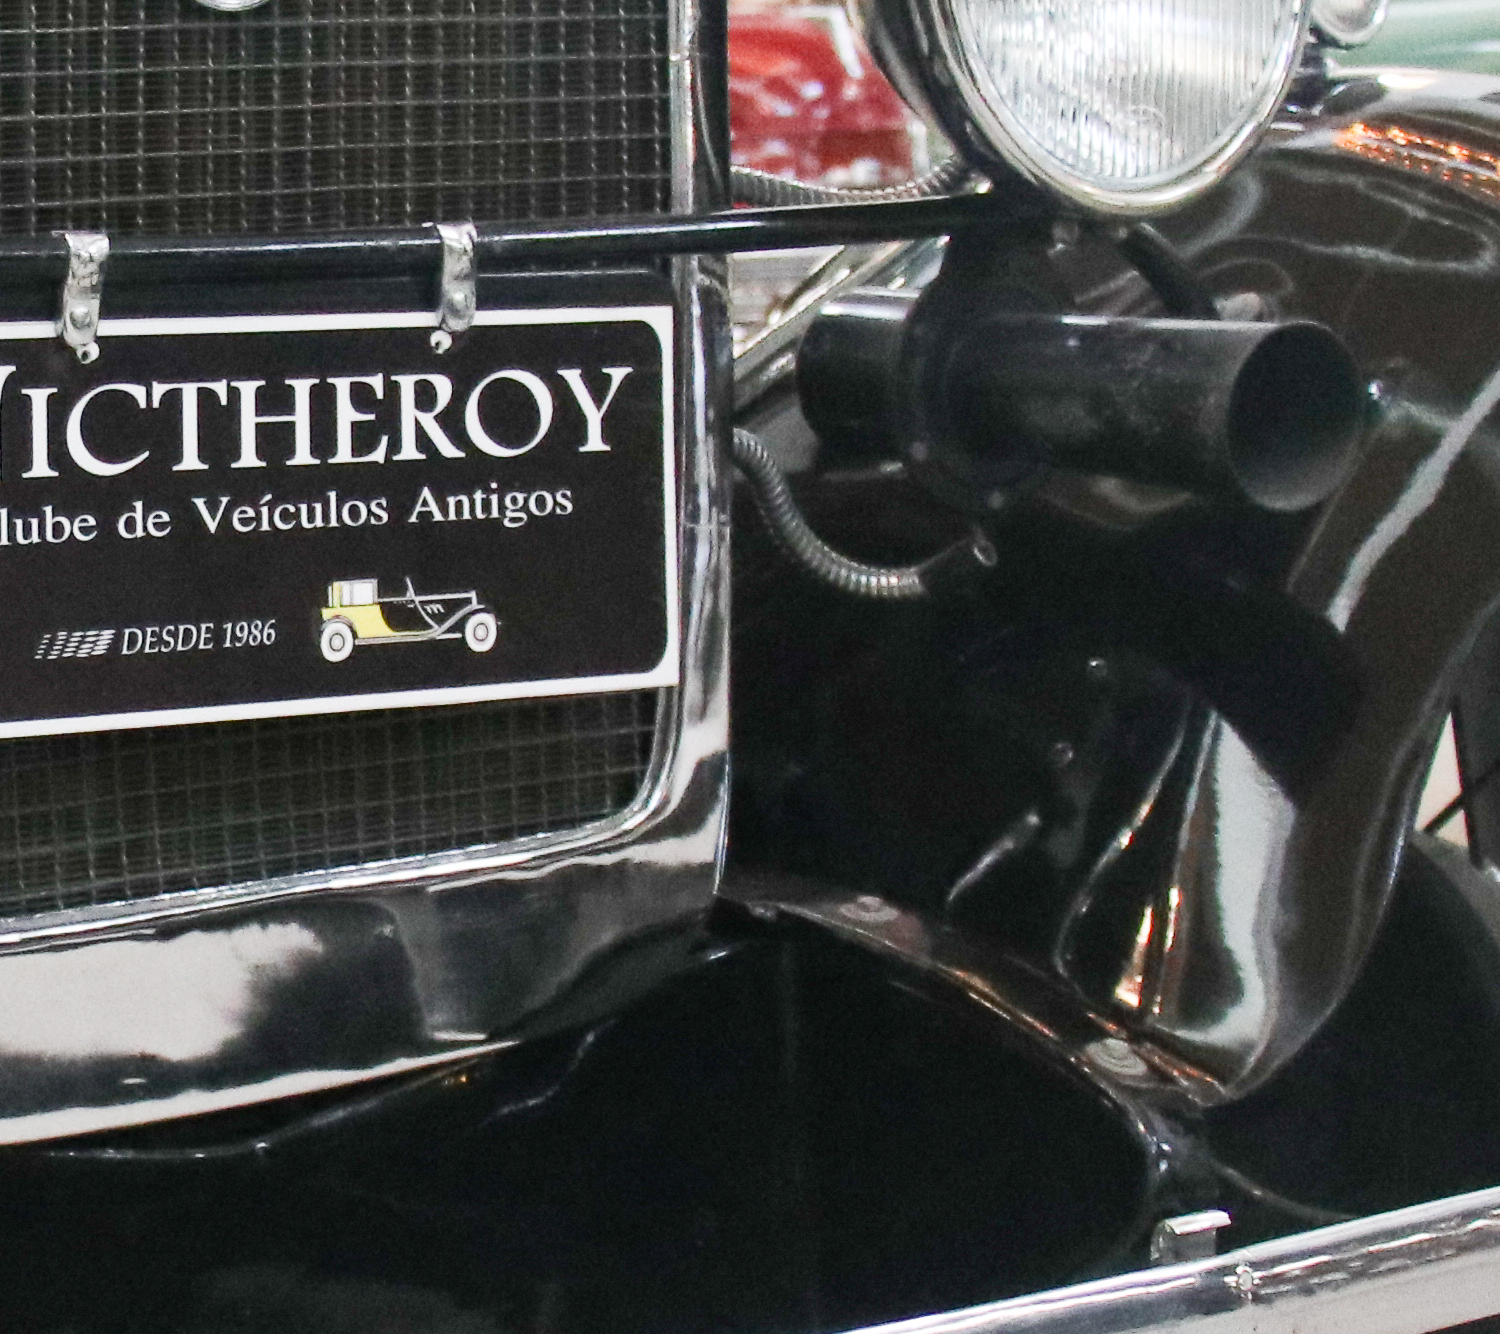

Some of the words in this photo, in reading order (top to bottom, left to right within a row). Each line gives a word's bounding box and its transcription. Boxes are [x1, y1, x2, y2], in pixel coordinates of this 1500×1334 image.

[117, 500, 172, 539] de
[191, 490, 390, 534] Veículos
[407, 481, 574, 529] Antigos
[121, 622, 215, 655] DESDE
[222, 619, 277, 649] 1986
